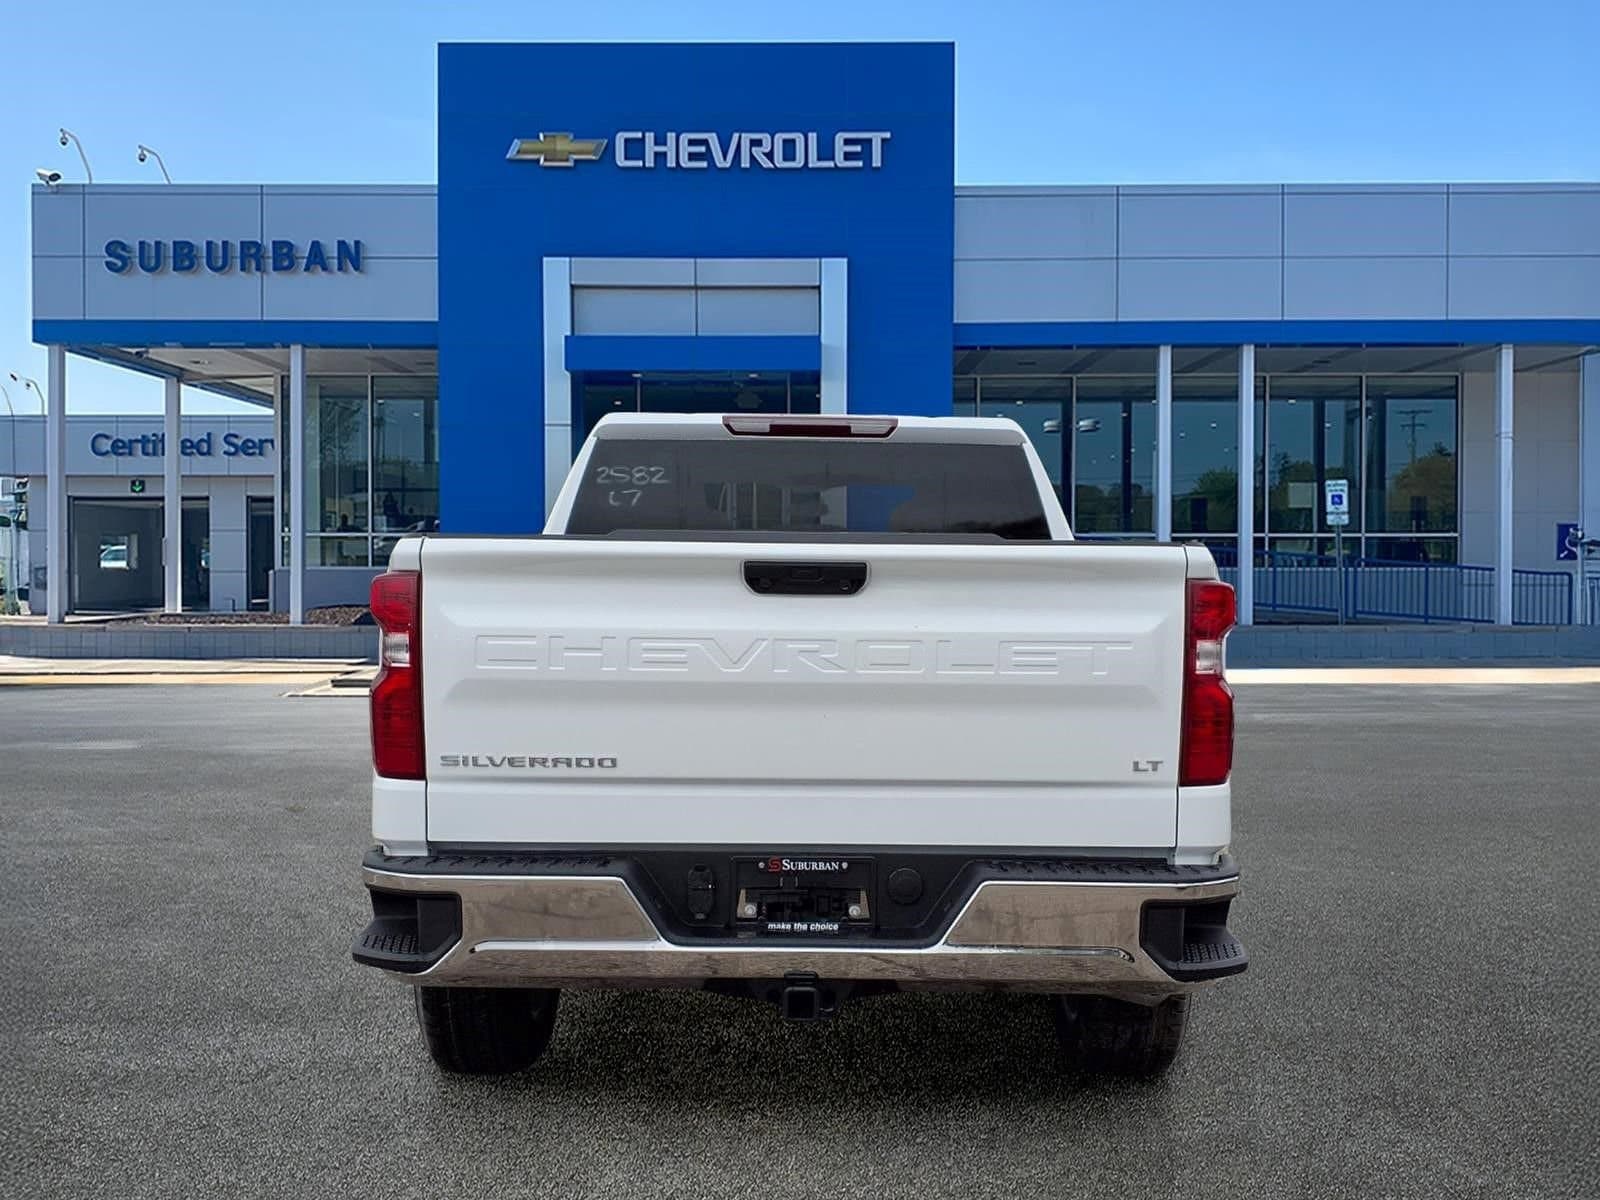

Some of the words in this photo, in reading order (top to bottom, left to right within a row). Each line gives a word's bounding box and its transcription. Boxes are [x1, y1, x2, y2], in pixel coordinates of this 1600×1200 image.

[614, 131, 891, 168] CHEVROLET
[105, 239, 365, 273] SUBURBAN
[90, 431, 213, 457] Certifed
[595, 465, 671, 485] 2582
[474, 634, 1134, 677] CHEVROLET
[439, 754, 618, 769] SILVERADO
[1132, 760, 1164, 772] LT
[767, 922, 791, 931] make
[793, 921, 808, 931] the
[809, 921, 839, 931] choice
